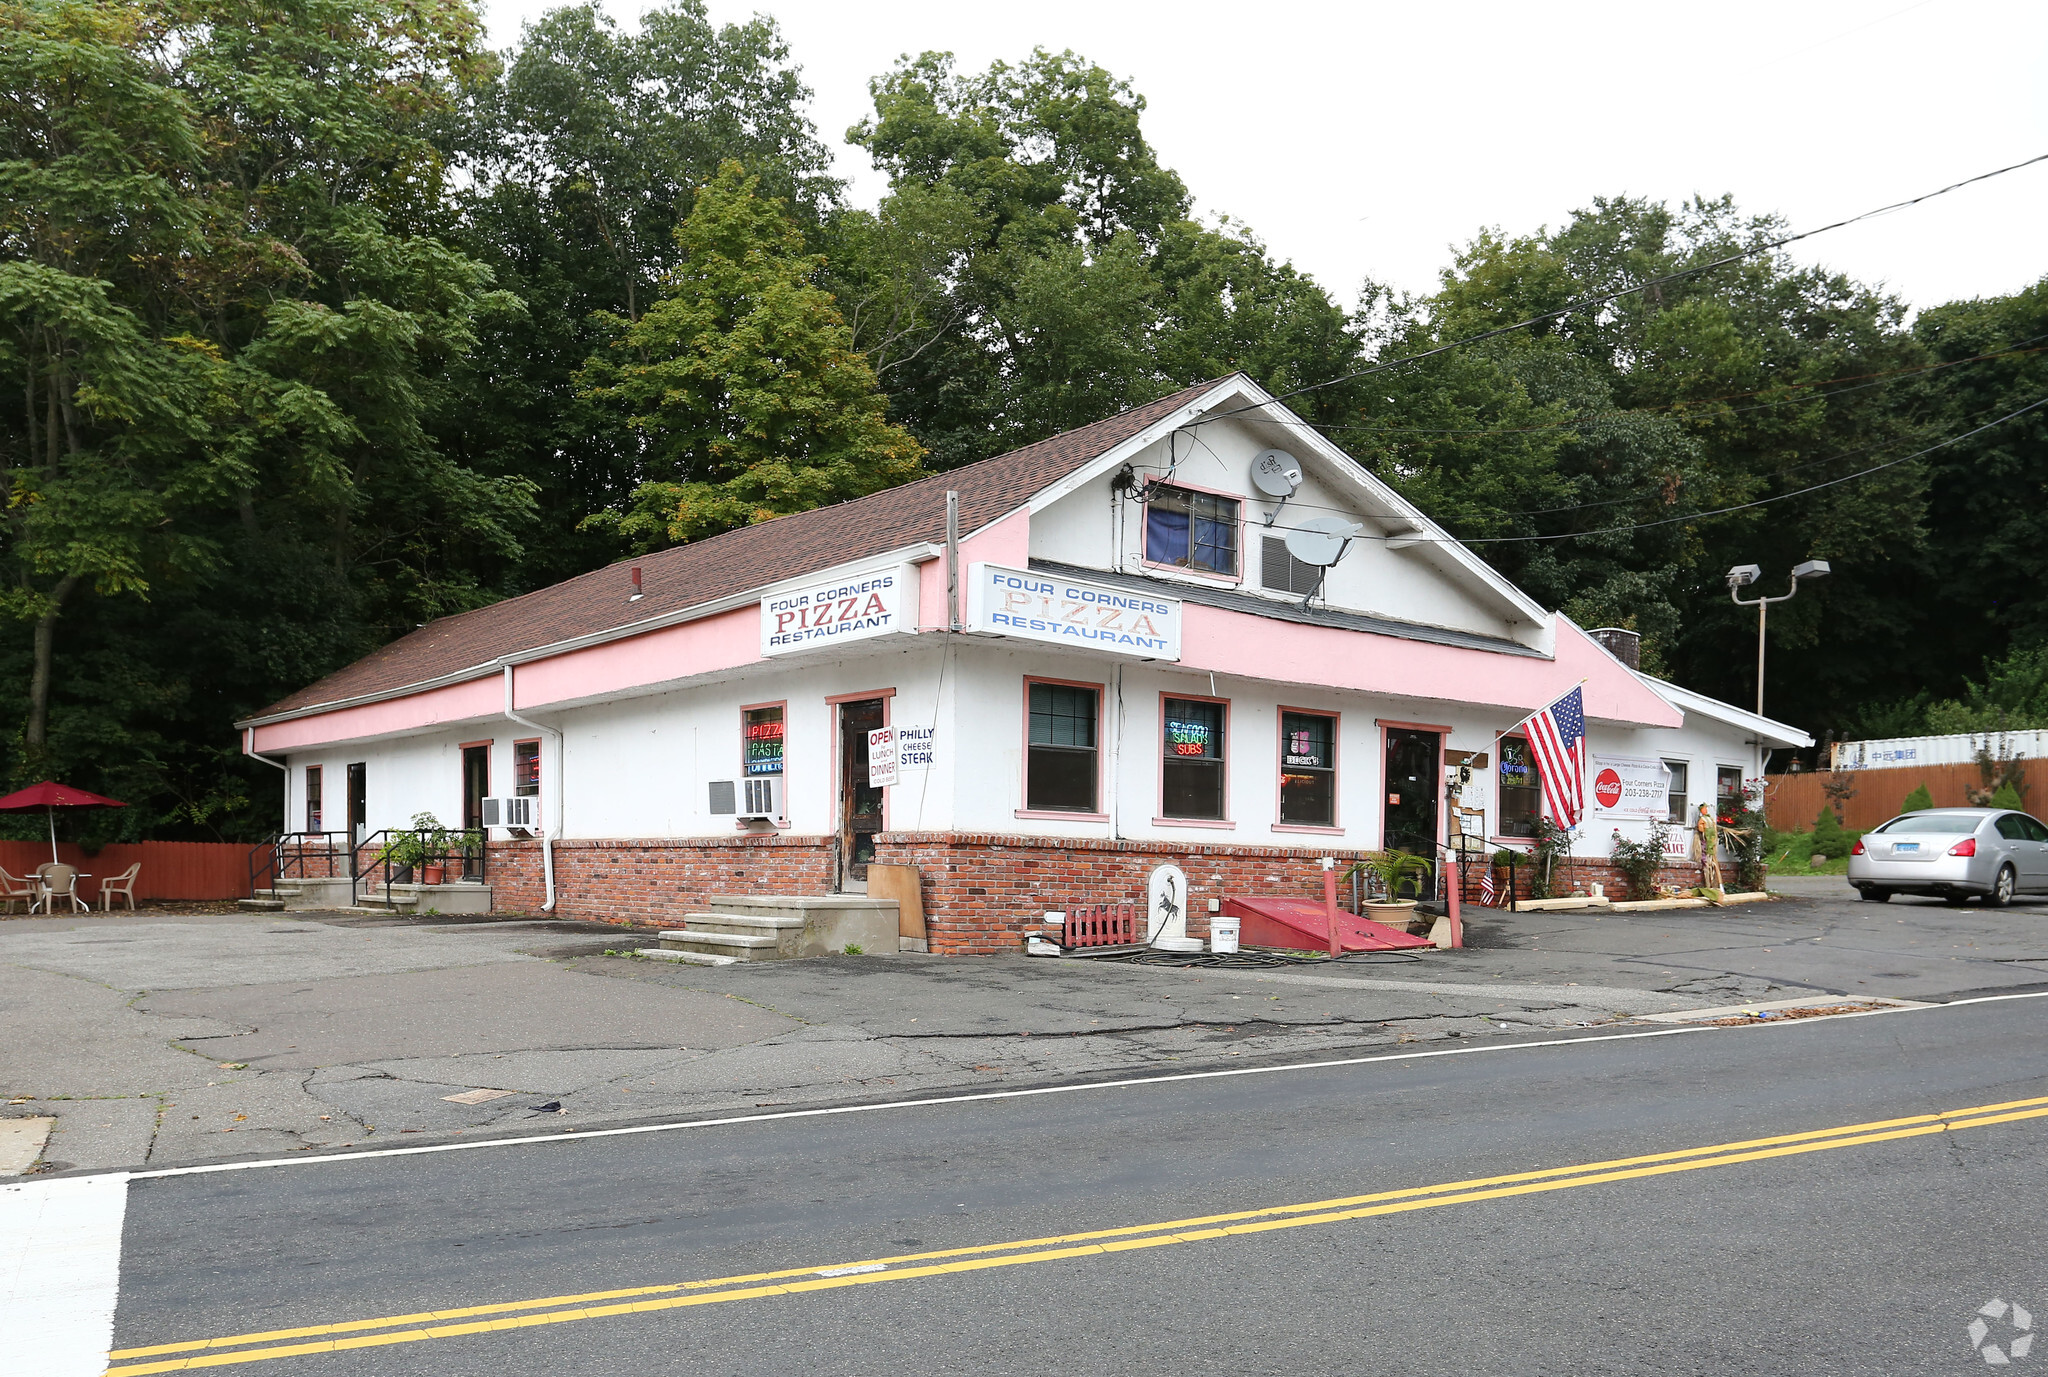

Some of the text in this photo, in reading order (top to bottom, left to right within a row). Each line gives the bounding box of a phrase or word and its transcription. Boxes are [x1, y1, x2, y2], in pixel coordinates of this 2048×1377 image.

[770, 576, 893, 612] FOUR CORNERS
[993, 574, 1169, 615] FOUR CORNERS
[775, 593, 887, 634] PIZZA
[999, 588, 1161, 637] PIZZA
[770, 614, 892, 647] RESTAURANT
[992, 613, 1168, 650] RESTAURANT
[870, 730, 893, 746] OPEN
[900, 728, 934, 740] PHILLY
[1173, 732, 1208, 744] SALADS
[752, 743, 784, 757] PASTA
[903, 742, 931, 751] CHEESE
[1178, 743, 1203, 755] SUBS
[872, 748, 894, 760] LUNCH
[901, 752, 933, 765] STEAK
[1872, 749, 1916, 761] 中远集团
[871, 761, 896, 777] DINNER
[1500, 761, 1529, 774] Corona
[1622, 779, 1634, 787] Four
[1624, 788, 1662, 798] 203-238-2717
[1663, 843, 1685, 854] SLICE
